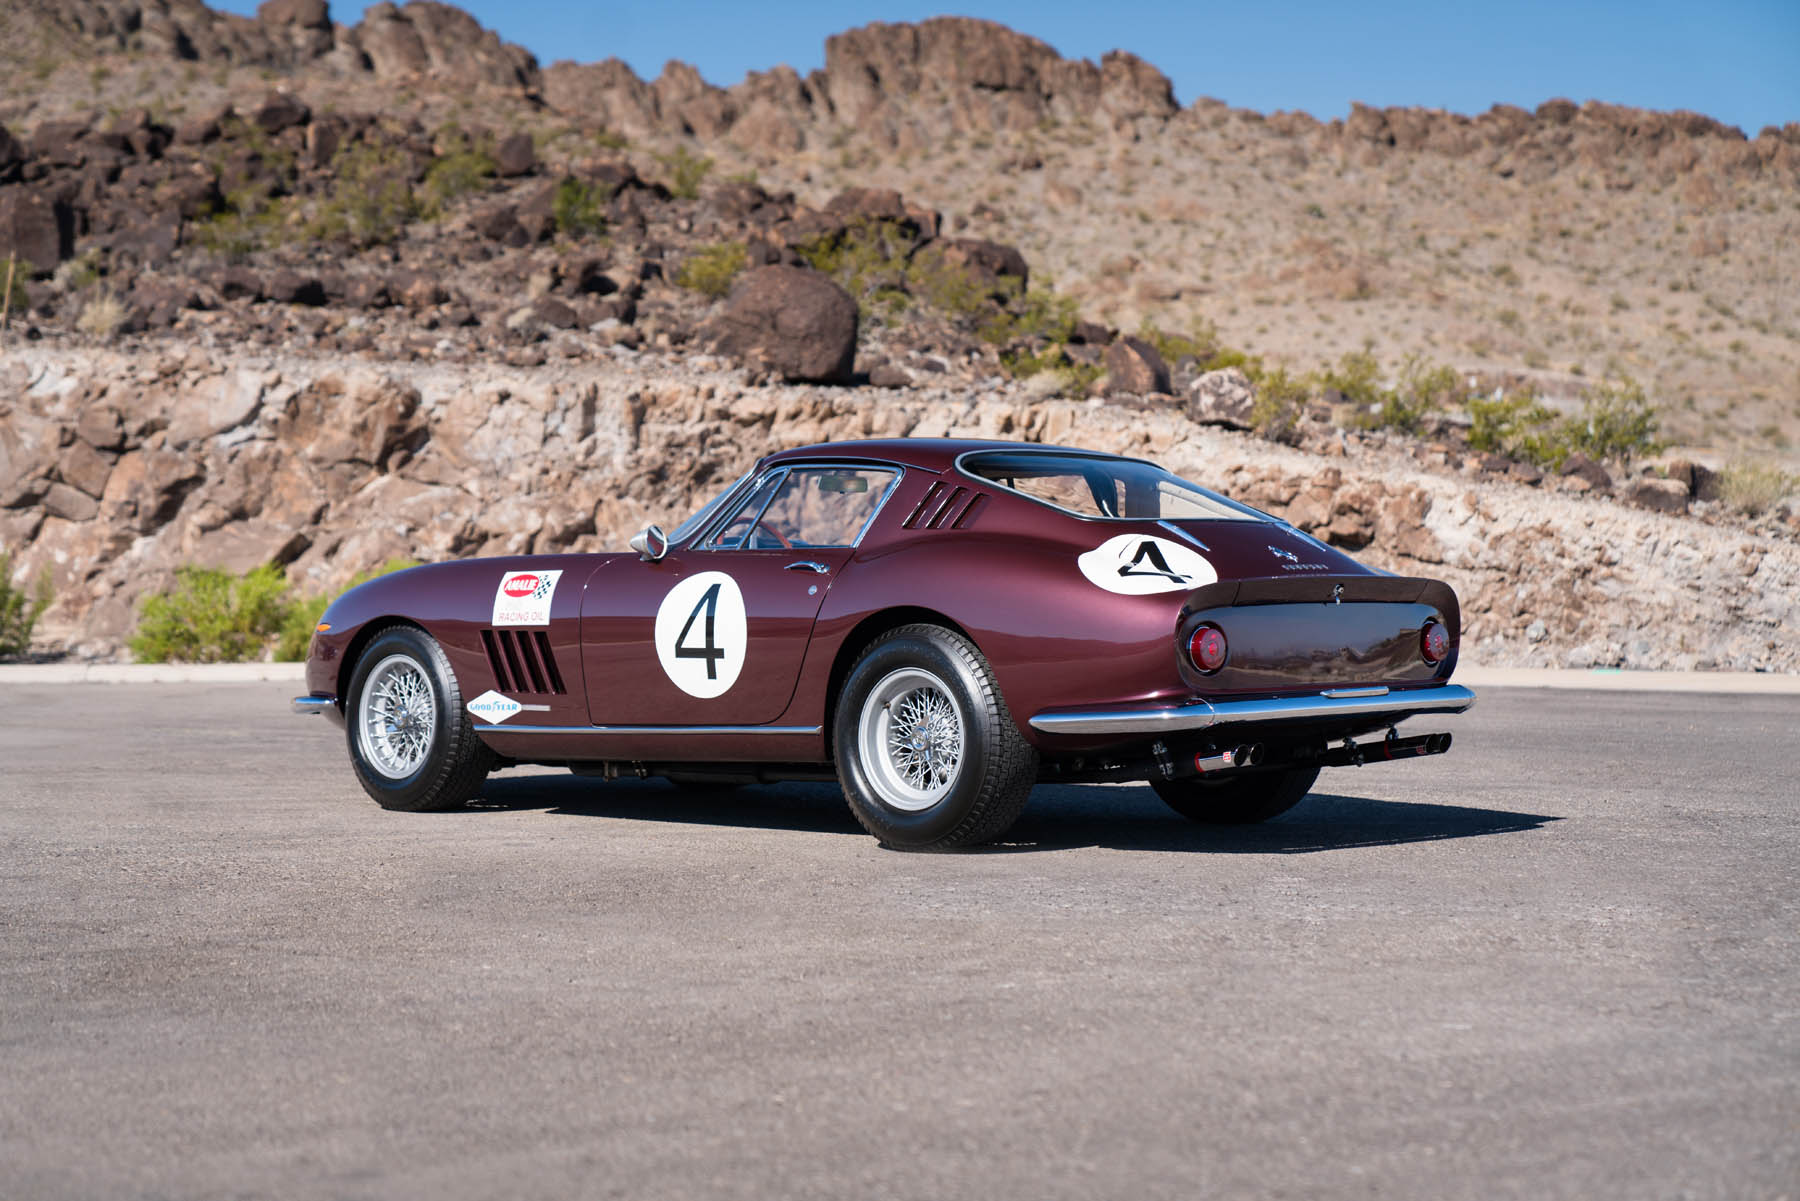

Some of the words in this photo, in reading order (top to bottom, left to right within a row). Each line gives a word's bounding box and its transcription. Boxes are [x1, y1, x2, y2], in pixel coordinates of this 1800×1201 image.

[498, 612, 529, 622] RACING
[531, 611, 544, 621] OIL
[675, 583, 725, 680] 4
